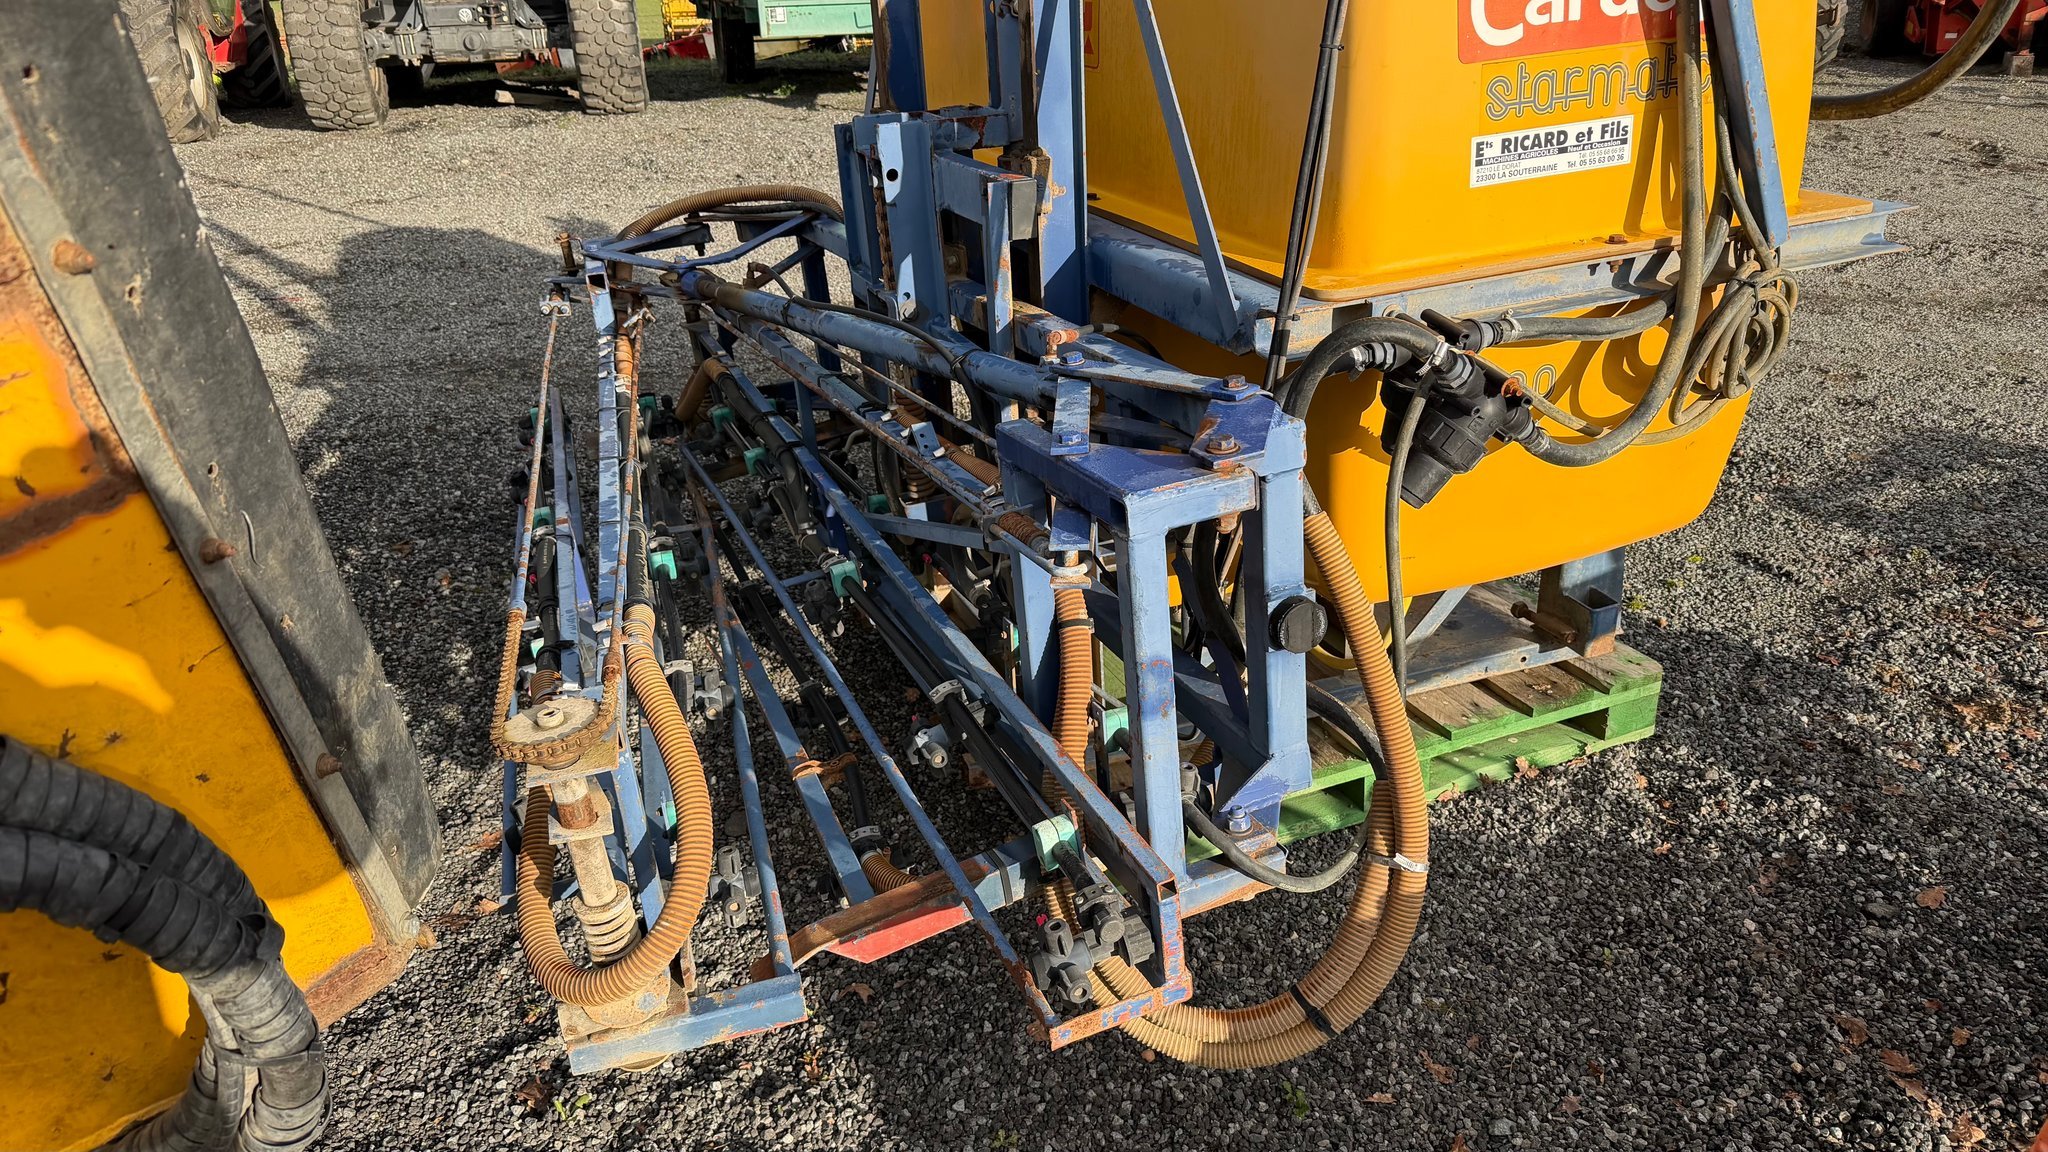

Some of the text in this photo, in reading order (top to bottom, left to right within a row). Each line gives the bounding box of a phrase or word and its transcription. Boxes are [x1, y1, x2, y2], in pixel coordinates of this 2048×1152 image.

[1501, 130, 1568, 154] RICARD
[1575, 127, 1593, 143] et
[1600, 121, 1629, 140] Fils
[1482, 153, 1519, 165] MACHINES
[1520, 148, 1559, 160] AGRICOLES
[1567, 145, 1583, 153] Neuf
[1592, 140, 1621, 149] Occasion
[1597, 156, 1605, 164] 63
[1475, 163, 1558, 183] 23300 LA SOUTERRAINE
[1493, 164, 1501, 172] LE
[1502, 162, 1521, 170] DORAT
